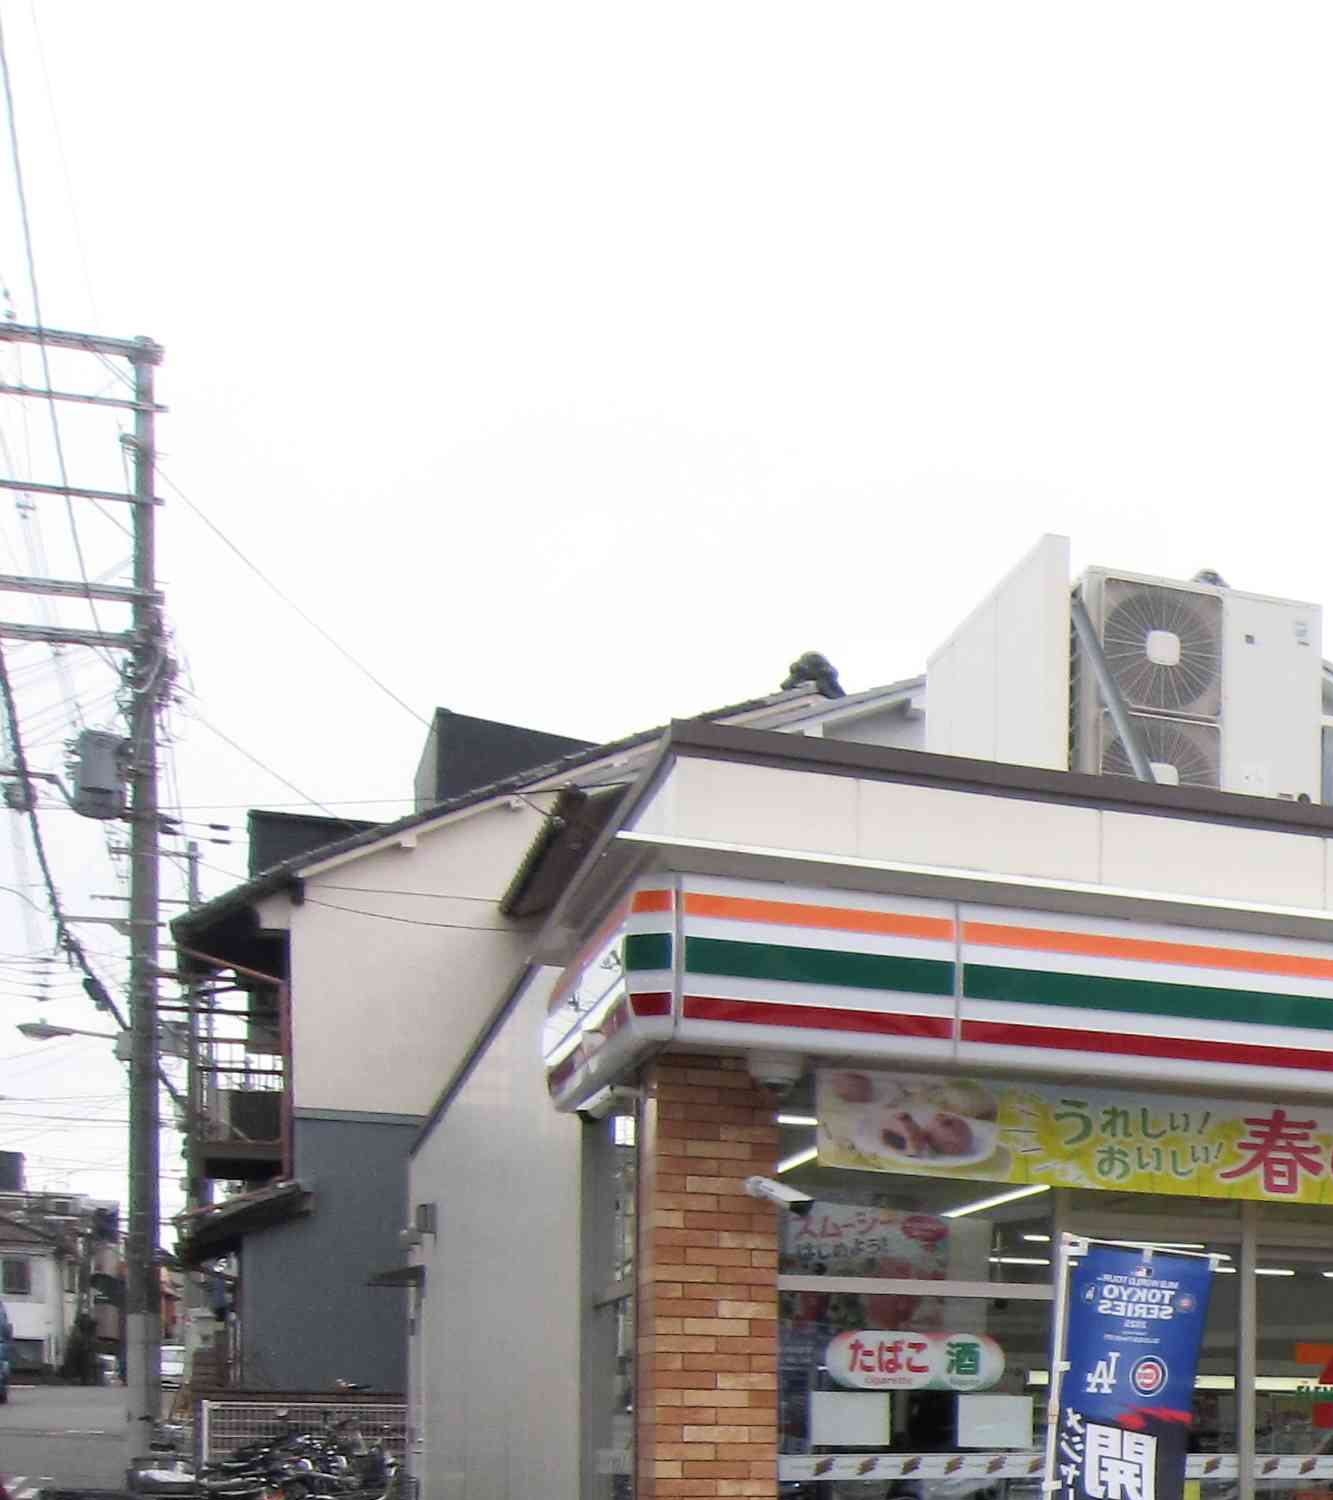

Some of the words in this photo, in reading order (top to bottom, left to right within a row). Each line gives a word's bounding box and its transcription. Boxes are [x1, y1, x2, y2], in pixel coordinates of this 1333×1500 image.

[848, 1338, 929, 1374] たばこ
[946, 1341, 981, 1375] 酒
